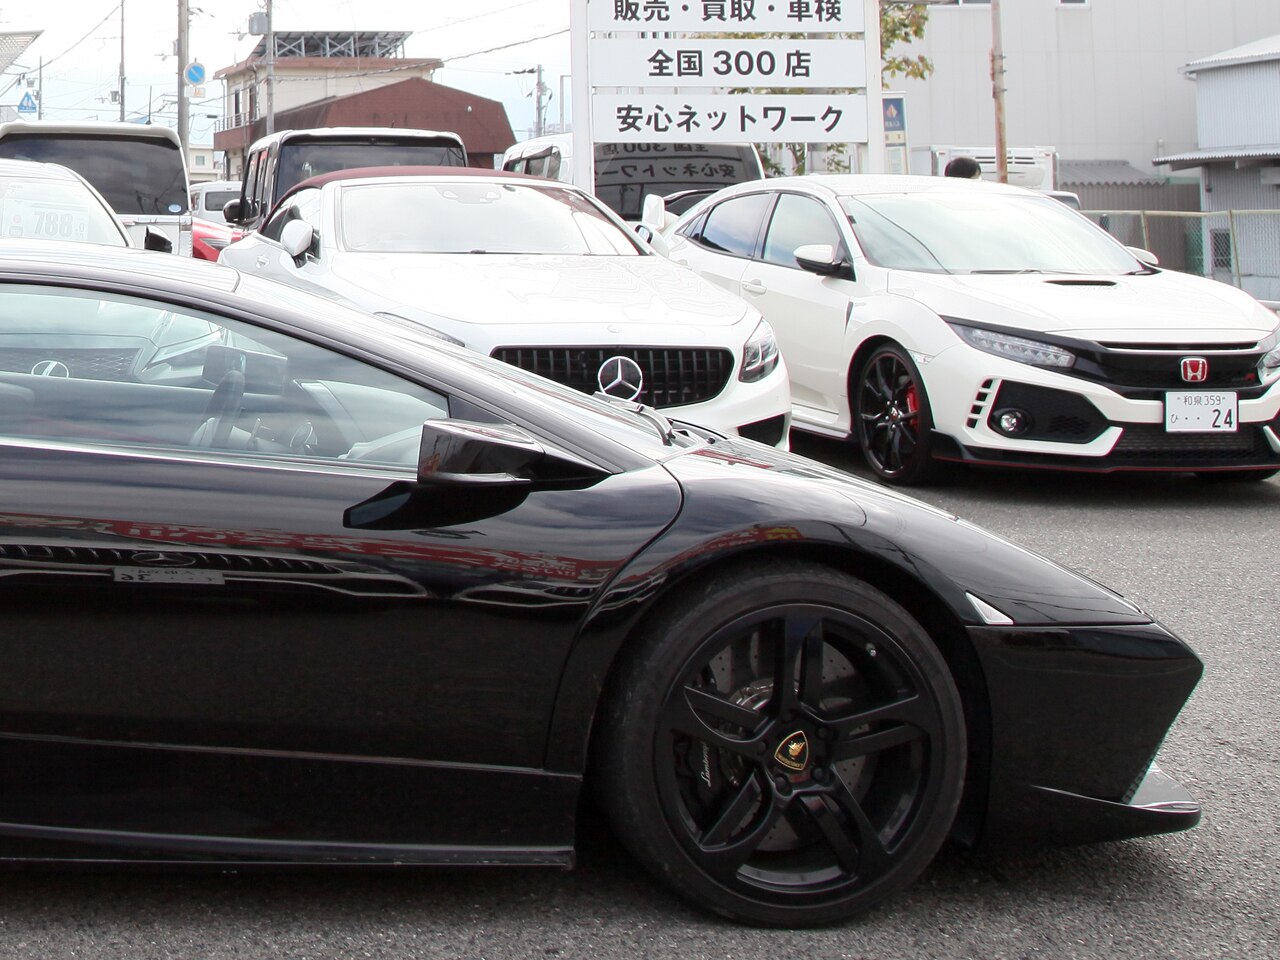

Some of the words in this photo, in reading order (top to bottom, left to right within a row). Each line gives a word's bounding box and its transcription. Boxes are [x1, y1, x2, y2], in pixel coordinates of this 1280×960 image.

[616, 104, 844, 133] 安心ネットワーク
[1211, 408, 1233, 428] 24
